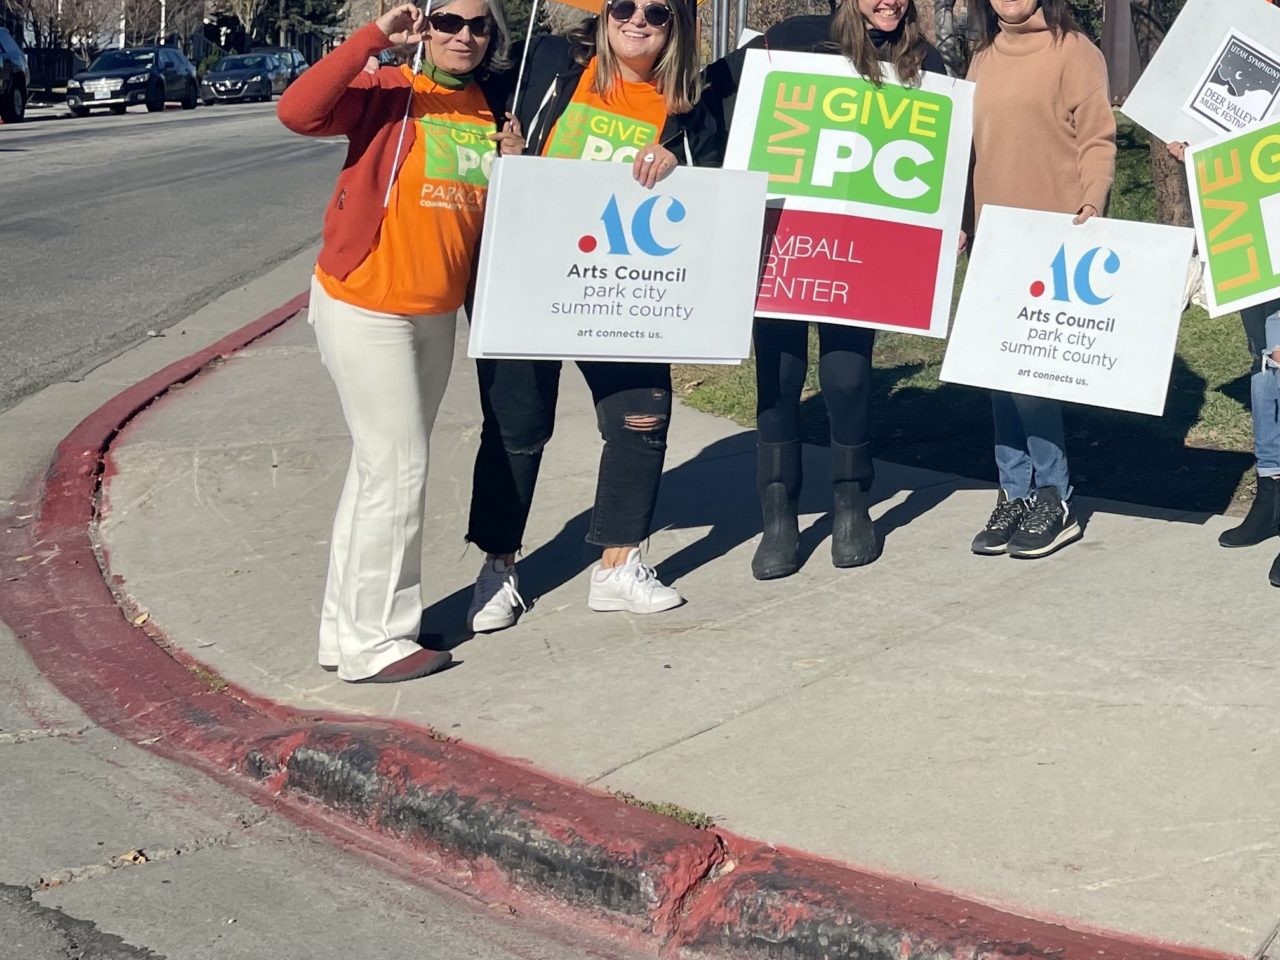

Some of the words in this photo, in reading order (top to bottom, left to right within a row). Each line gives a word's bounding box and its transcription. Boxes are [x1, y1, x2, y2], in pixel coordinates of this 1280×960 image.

[1230, 44, 1248, 60] UTAH
[1247, 55, 1280, 79] SYMPHONY
[1204, 87, 1226, 107] DEER
[822, 87, 940, 138] GIVE
[1200, 97, 1220, 115] MUSIC
[1220, 110, 1246, 129] FESTIV
[590, 115, 651, 146] GIVE
[767, 82, 817, 184] LIVE
[810, 127, 934, 199] PC
[1199, 148, 1261, 292] LIVE
[766, 234, 863, 263] IMBALL
[567, 263, 608, 281] Arts
[614, 266, 687, 283] Council
[761, 254, 797, 277] RT
[583, 283, 626, 299] park
[631, 285, 667, 303] city
[757, 275, 849, 304] ENTER
[551, 300, 622, 317] summit
[628, 303, 694, 321] county
[1017, 306, 1050, 323] Arts
[1055, 311, 1115, 333] Council
[577, 328, 594, 339] art
[596, 328, 644, 339] connects
[648, 330, 663, 340] us.
[1027, 325, 1062, 343] park
[1067, 330, 1097, 350] city
[1000, 340, 1058, 360] summit
[1062, 348, 1118, 370] county
[1017, 367, 1031, 378] art
[1033, 370, 1073, 384] connects
[1075, 376, 1089, 387] us.
